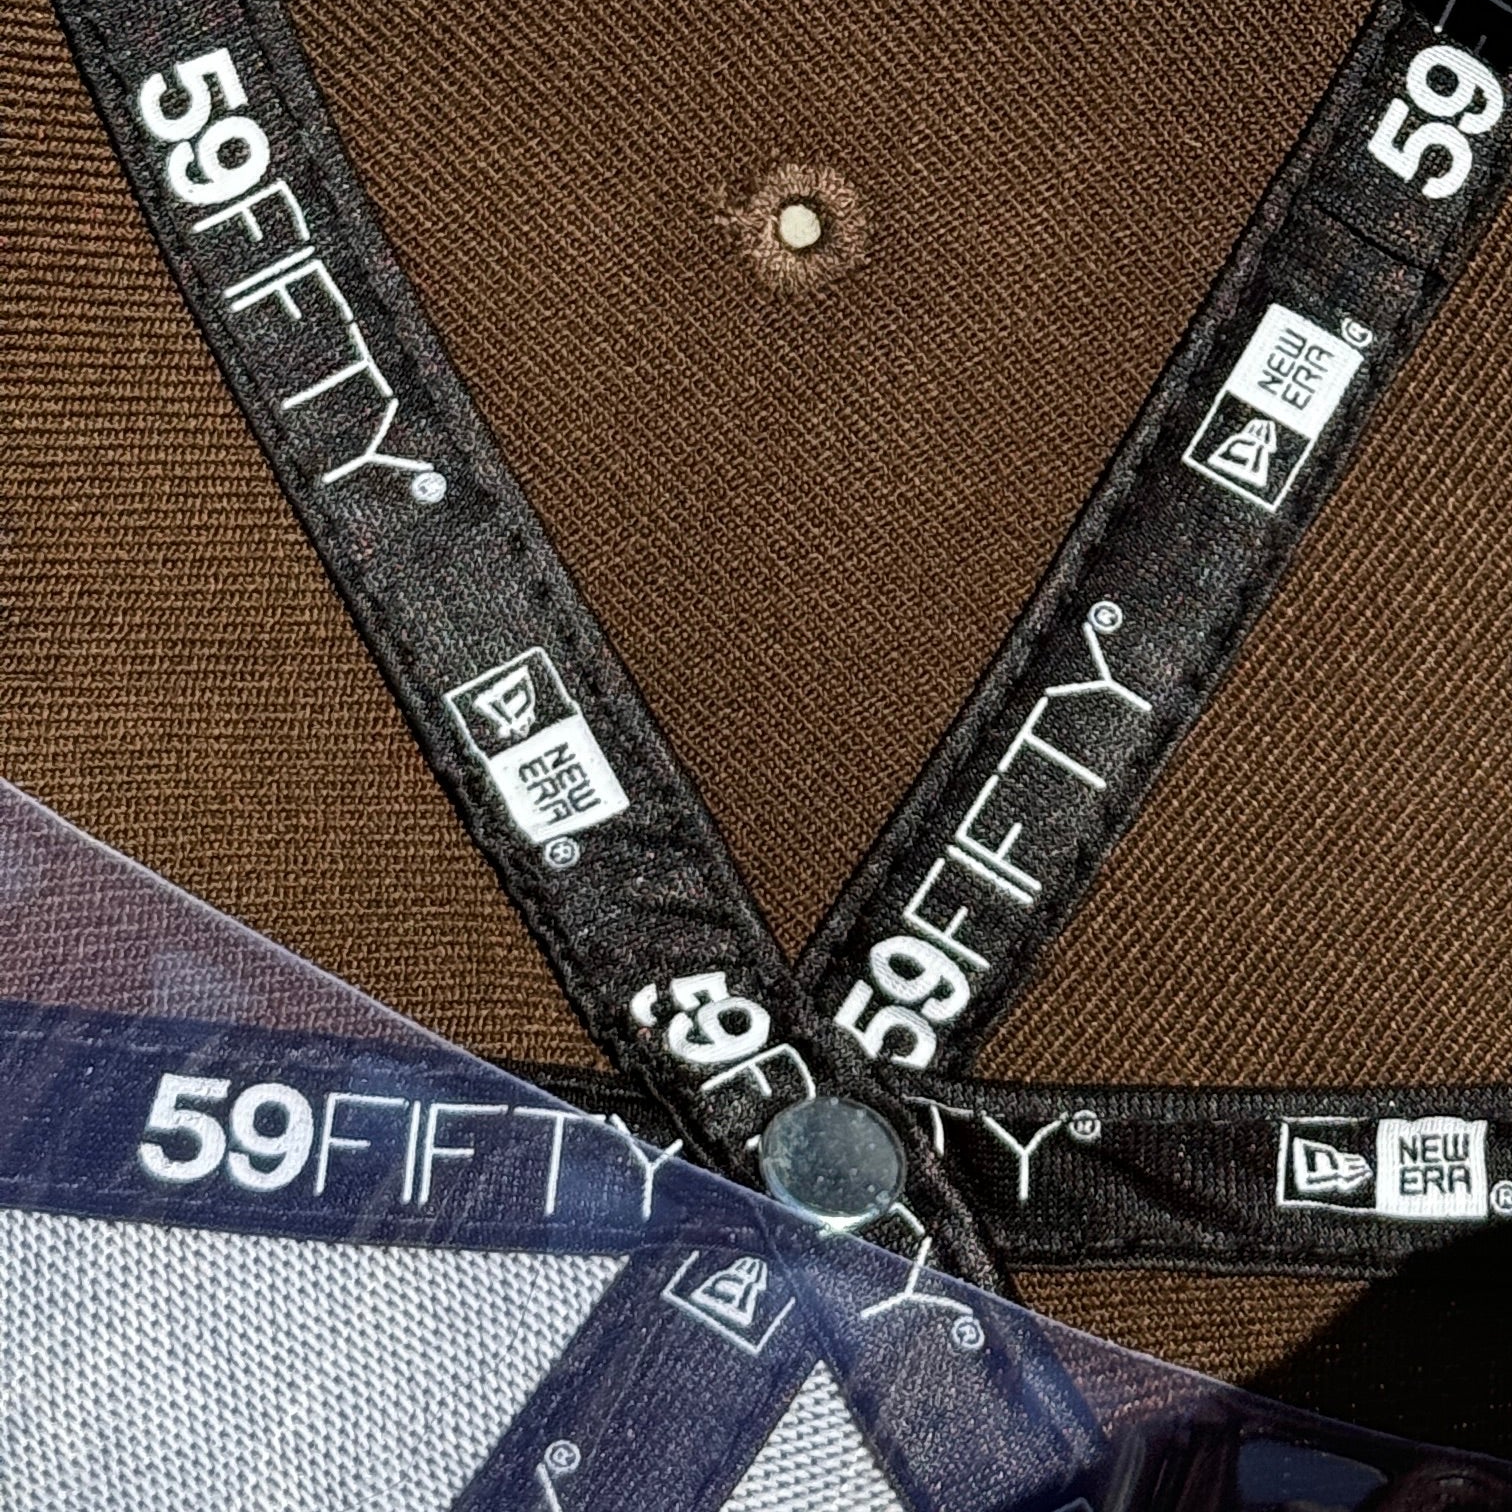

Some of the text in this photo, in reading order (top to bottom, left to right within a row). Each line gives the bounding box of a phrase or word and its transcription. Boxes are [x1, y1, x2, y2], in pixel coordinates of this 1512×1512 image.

[1256, 325, 1309, 396] NEW
[1281, 346, 1334, 411] ERA
[517, 759, 572, 825] ERA
[543, 741, 602, 814] NEW
[137, 1071, 683, 1221] 59FIFTY
[1398, 1132, 1471, 1165] NEW
[1398, 1165, 1471, 1196] ERA
